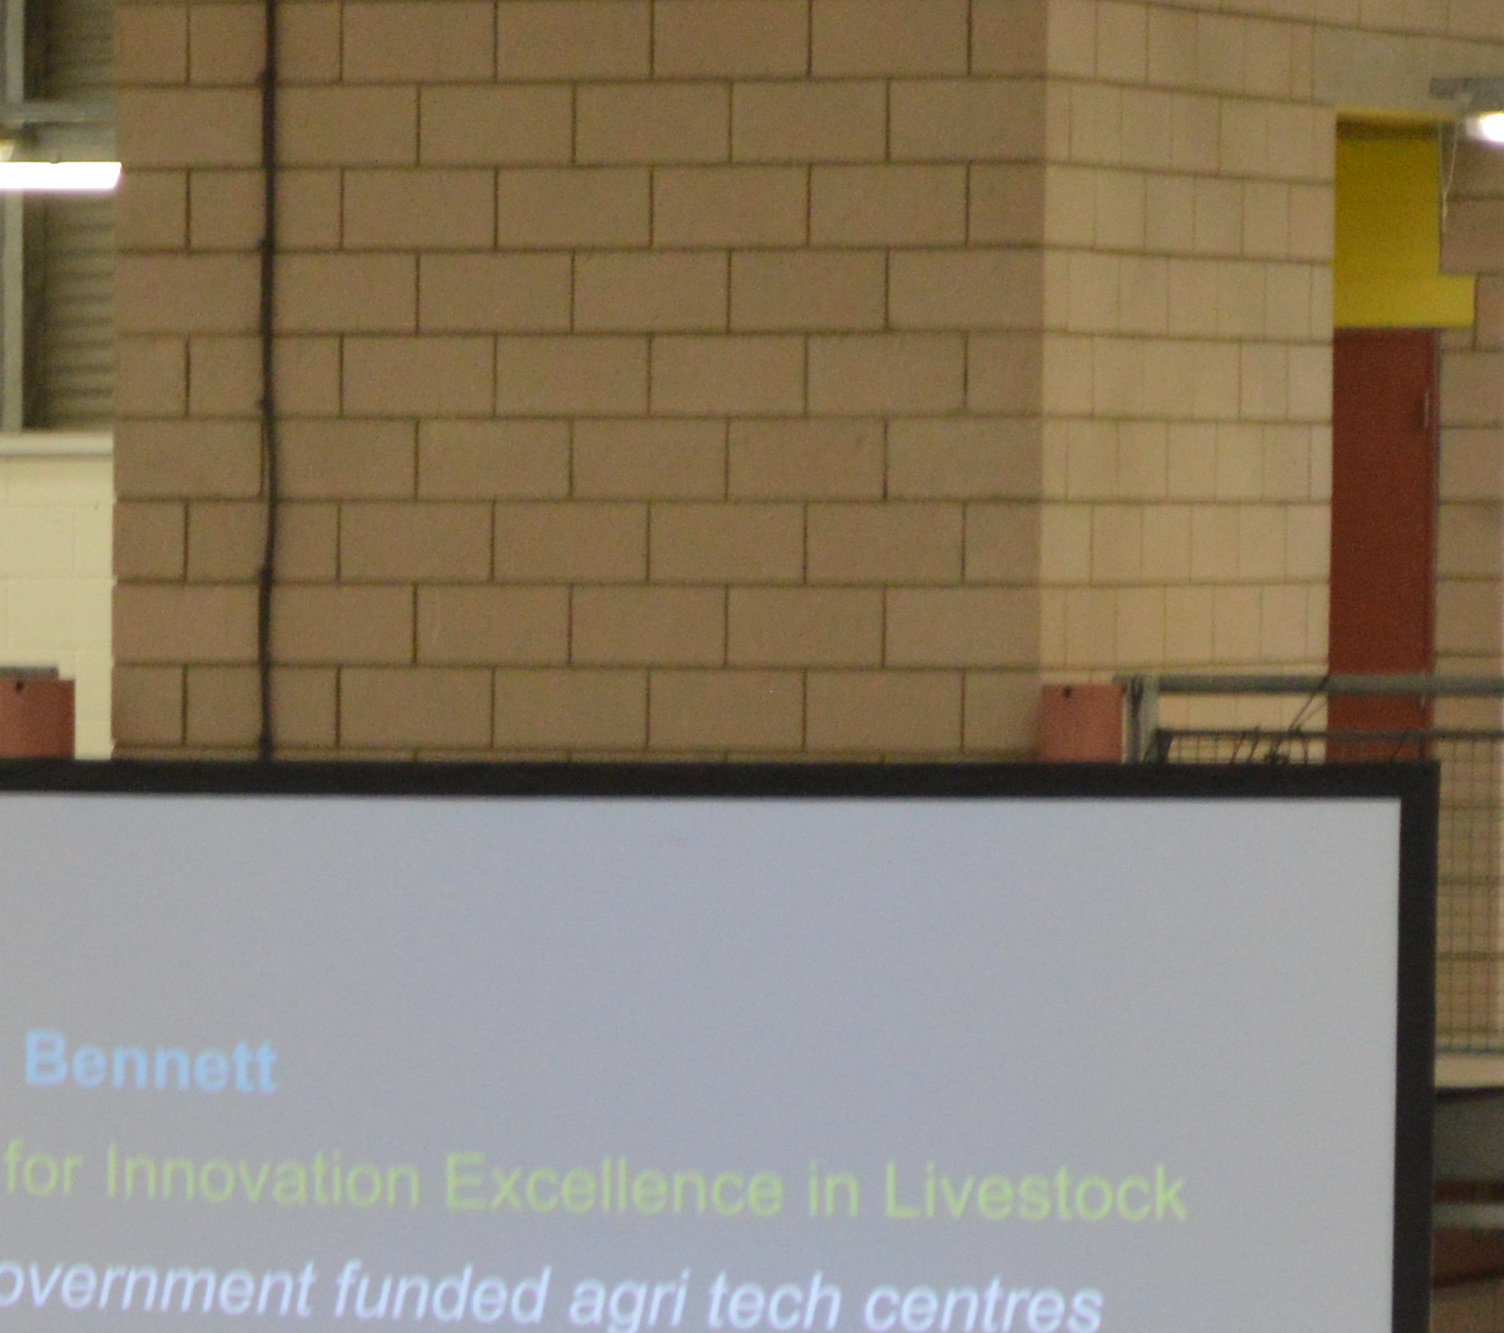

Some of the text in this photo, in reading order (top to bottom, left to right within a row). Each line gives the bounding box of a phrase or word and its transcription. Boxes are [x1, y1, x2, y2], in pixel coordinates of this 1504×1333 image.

[24, 1030, 279, 1095] Bennett
[4, 1137, 85, 1198] for
[107, 1142, 420, 1211] Innovation
[446, 1151, 784, 1218] Excellence
[809, 1159, 860, 1219] in
[885, 1161, 1189, 1223] Livestock
[334, 1258, 552, 1323] funded
[707, 1272, 842, 1333] tech
